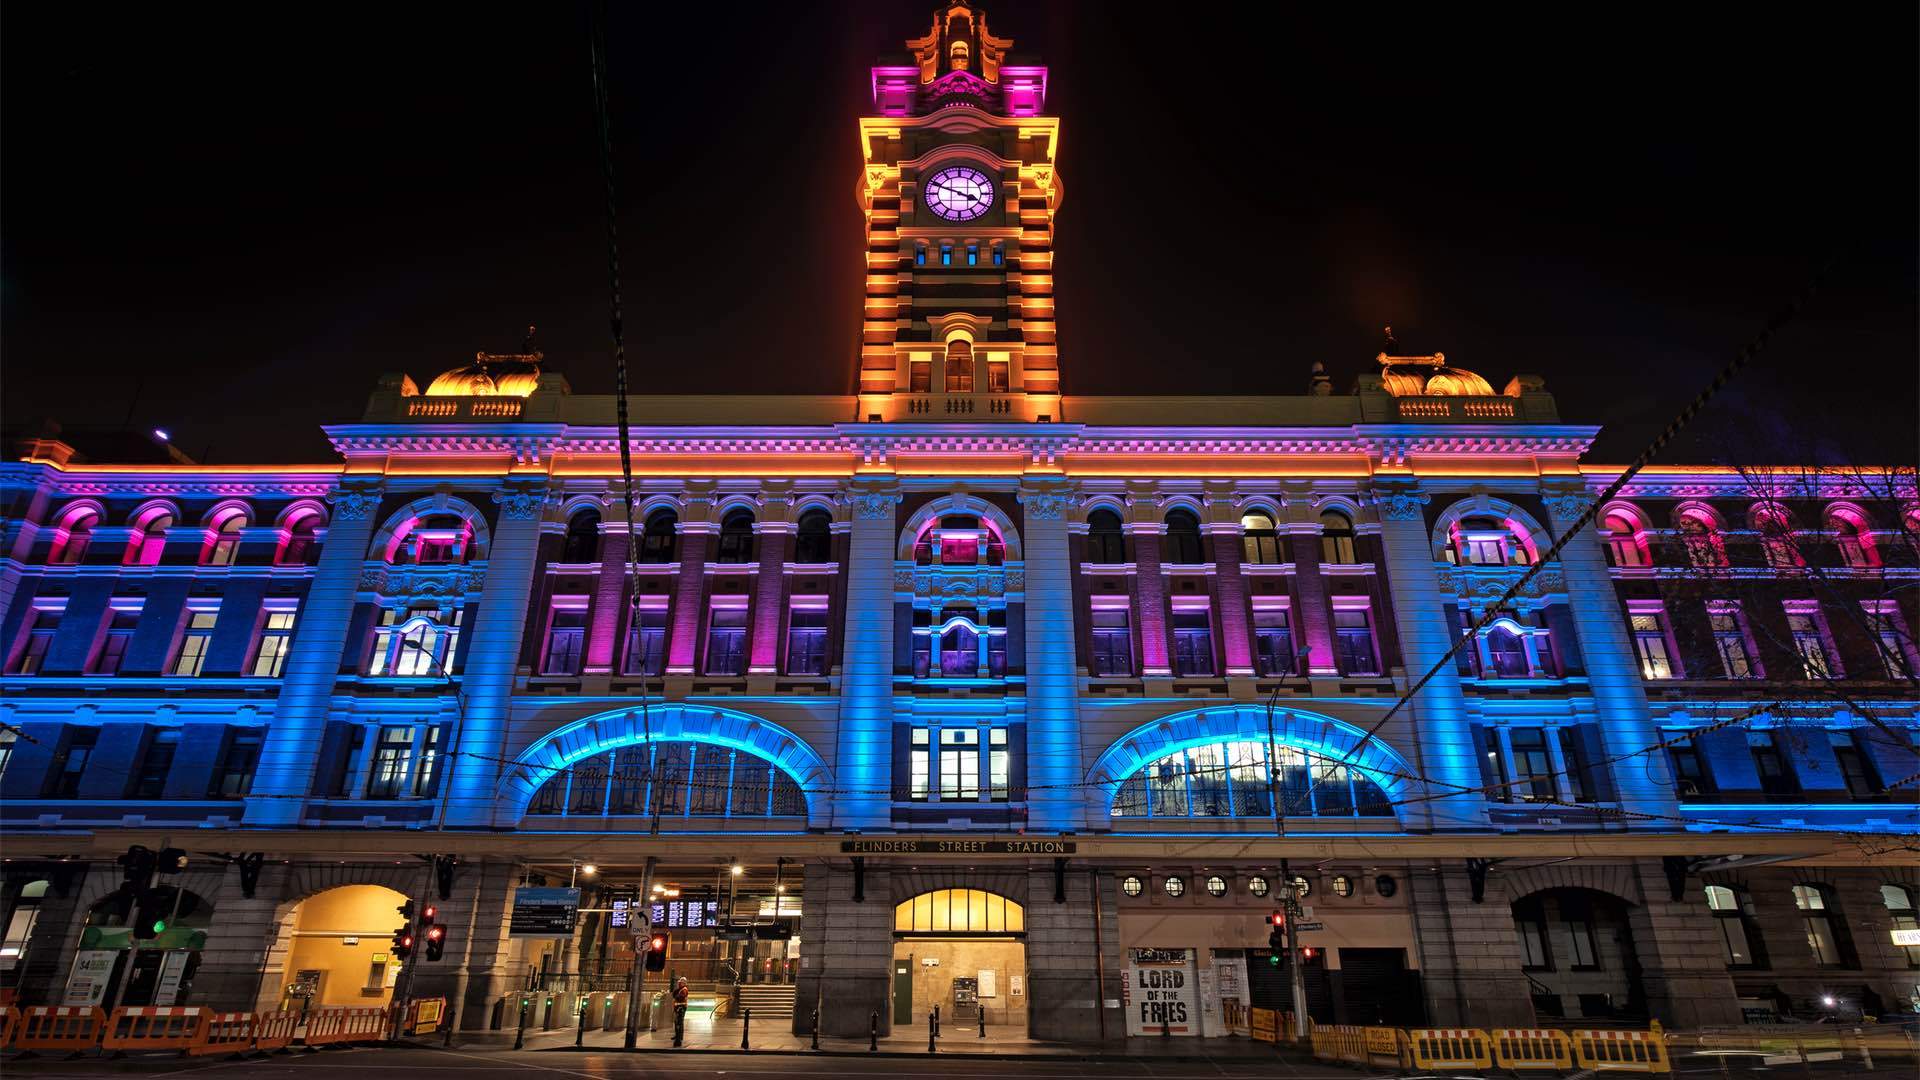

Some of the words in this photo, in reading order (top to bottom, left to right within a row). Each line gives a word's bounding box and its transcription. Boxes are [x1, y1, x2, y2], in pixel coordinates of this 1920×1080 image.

[854, 841, 917, 852] FLINDERS
[938, 841, 986, 852] STREET
[1007, 841, 1064, 853] STATION
[1139, 970, 1185, 989] LORD
[1147, 990, 1159, 1000] OF
[1162, 990, 1178, 1000] THE
[1370, 1030, 1390, 1040] ROAD
[1368, 1041, 1395, 1052] CLOSED
